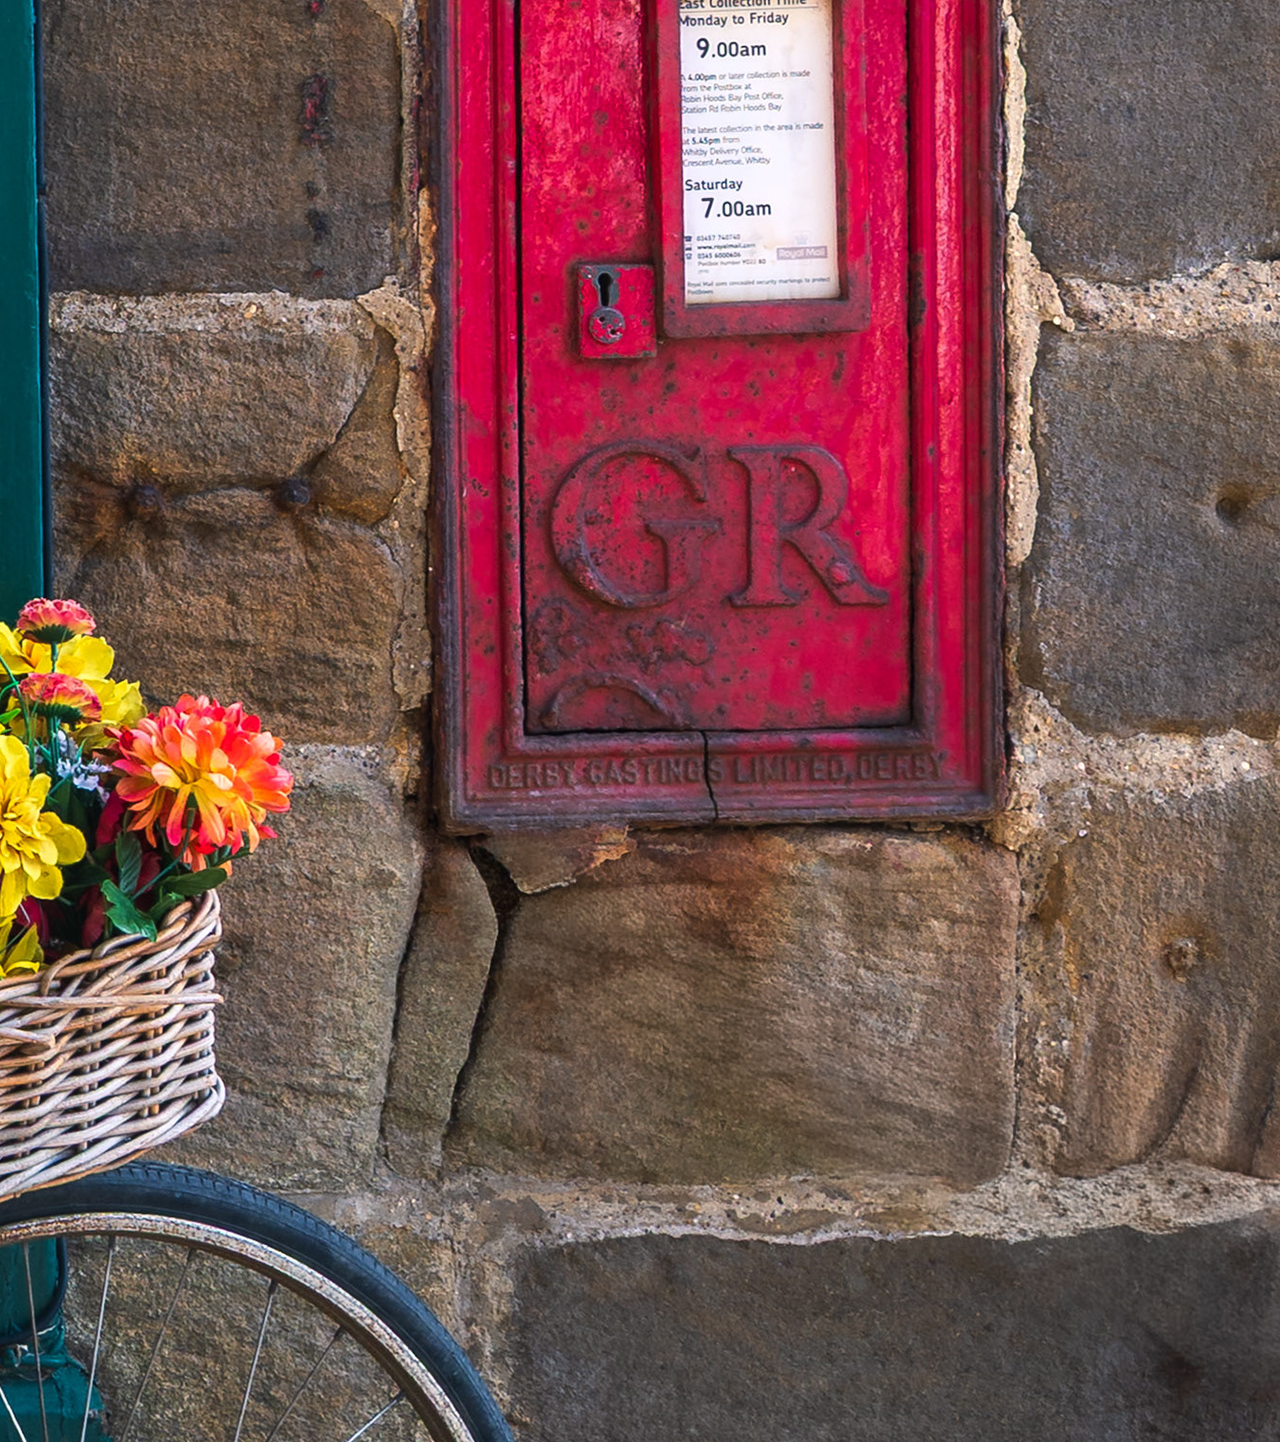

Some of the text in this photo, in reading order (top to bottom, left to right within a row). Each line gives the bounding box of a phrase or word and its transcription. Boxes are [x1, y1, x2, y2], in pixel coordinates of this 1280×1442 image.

[680, 12, 789, 28] Monday to Friday
[696, 37, 767, 59] 9.00am
[685, 178, 743, 192] Saturday
[701, 197, 771, 219] 7.00am
[551, 438, 890, 609] GR
[490, 758, 576, 789] DERBY
[589, 755, 725, 787] CASTINGS
[855, 750, 948, 781] DERBY
